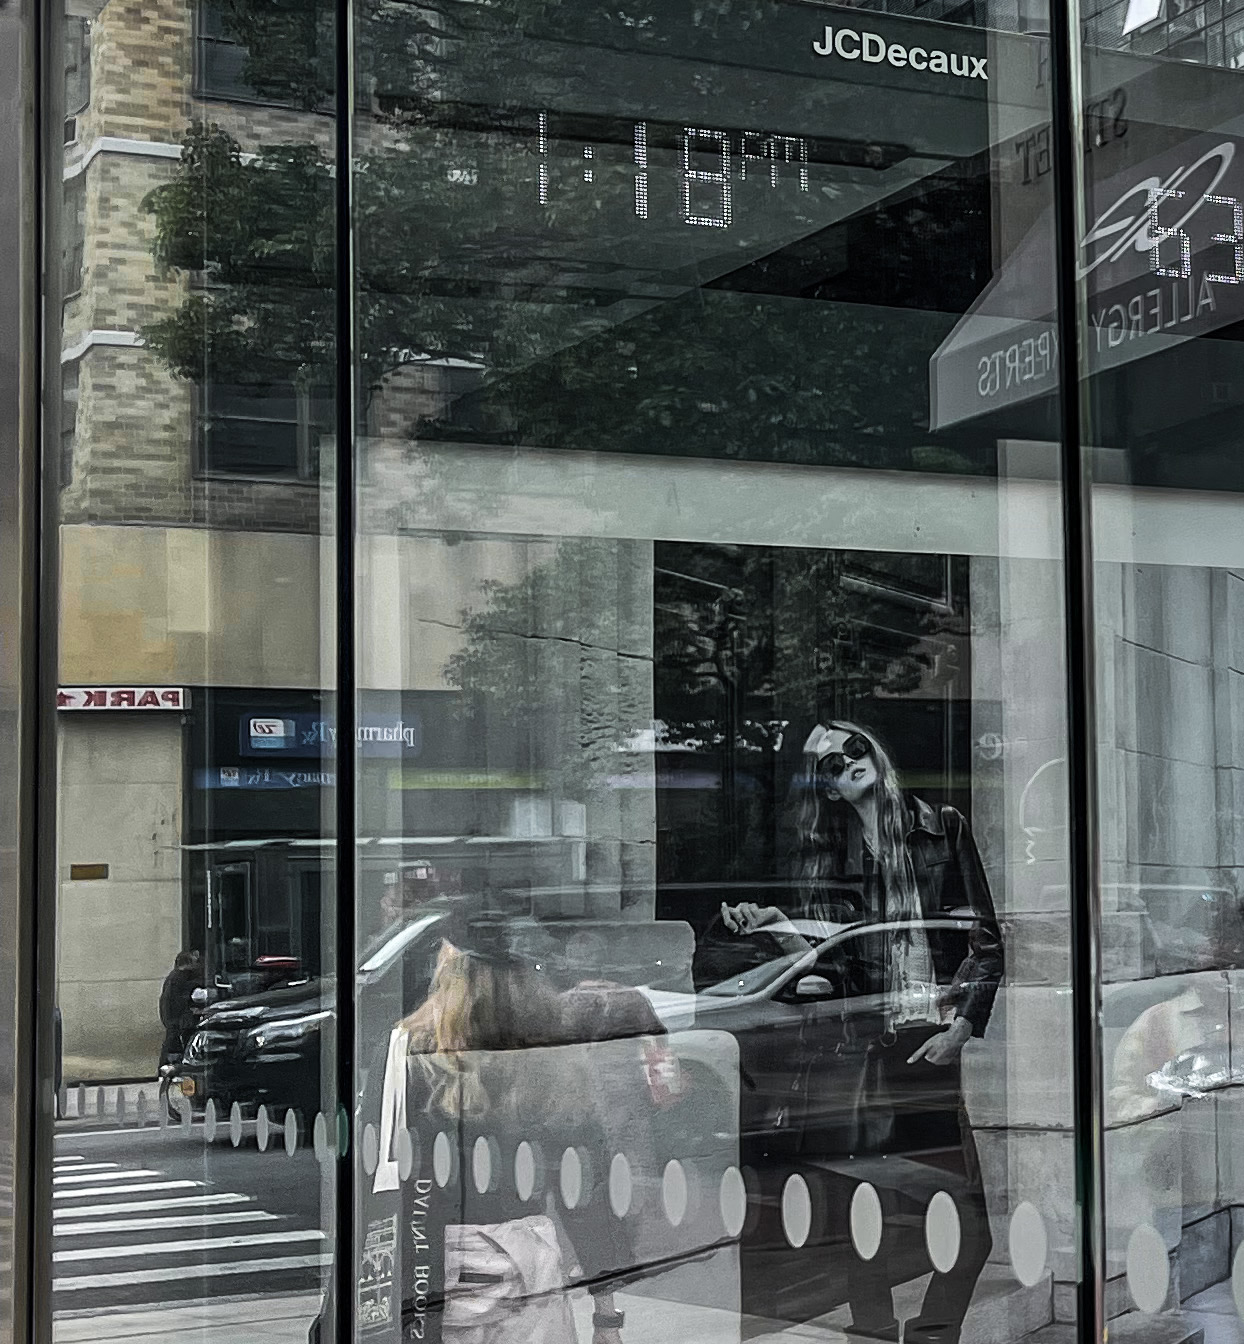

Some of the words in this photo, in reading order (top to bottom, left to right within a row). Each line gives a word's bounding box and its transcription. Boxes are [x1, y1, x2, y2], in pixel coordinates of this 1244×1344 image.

[813, 25, 989, 81] JCDecaux
[538, 109, 732, 229] 1:18
[740, 130, 809, 192] PM
